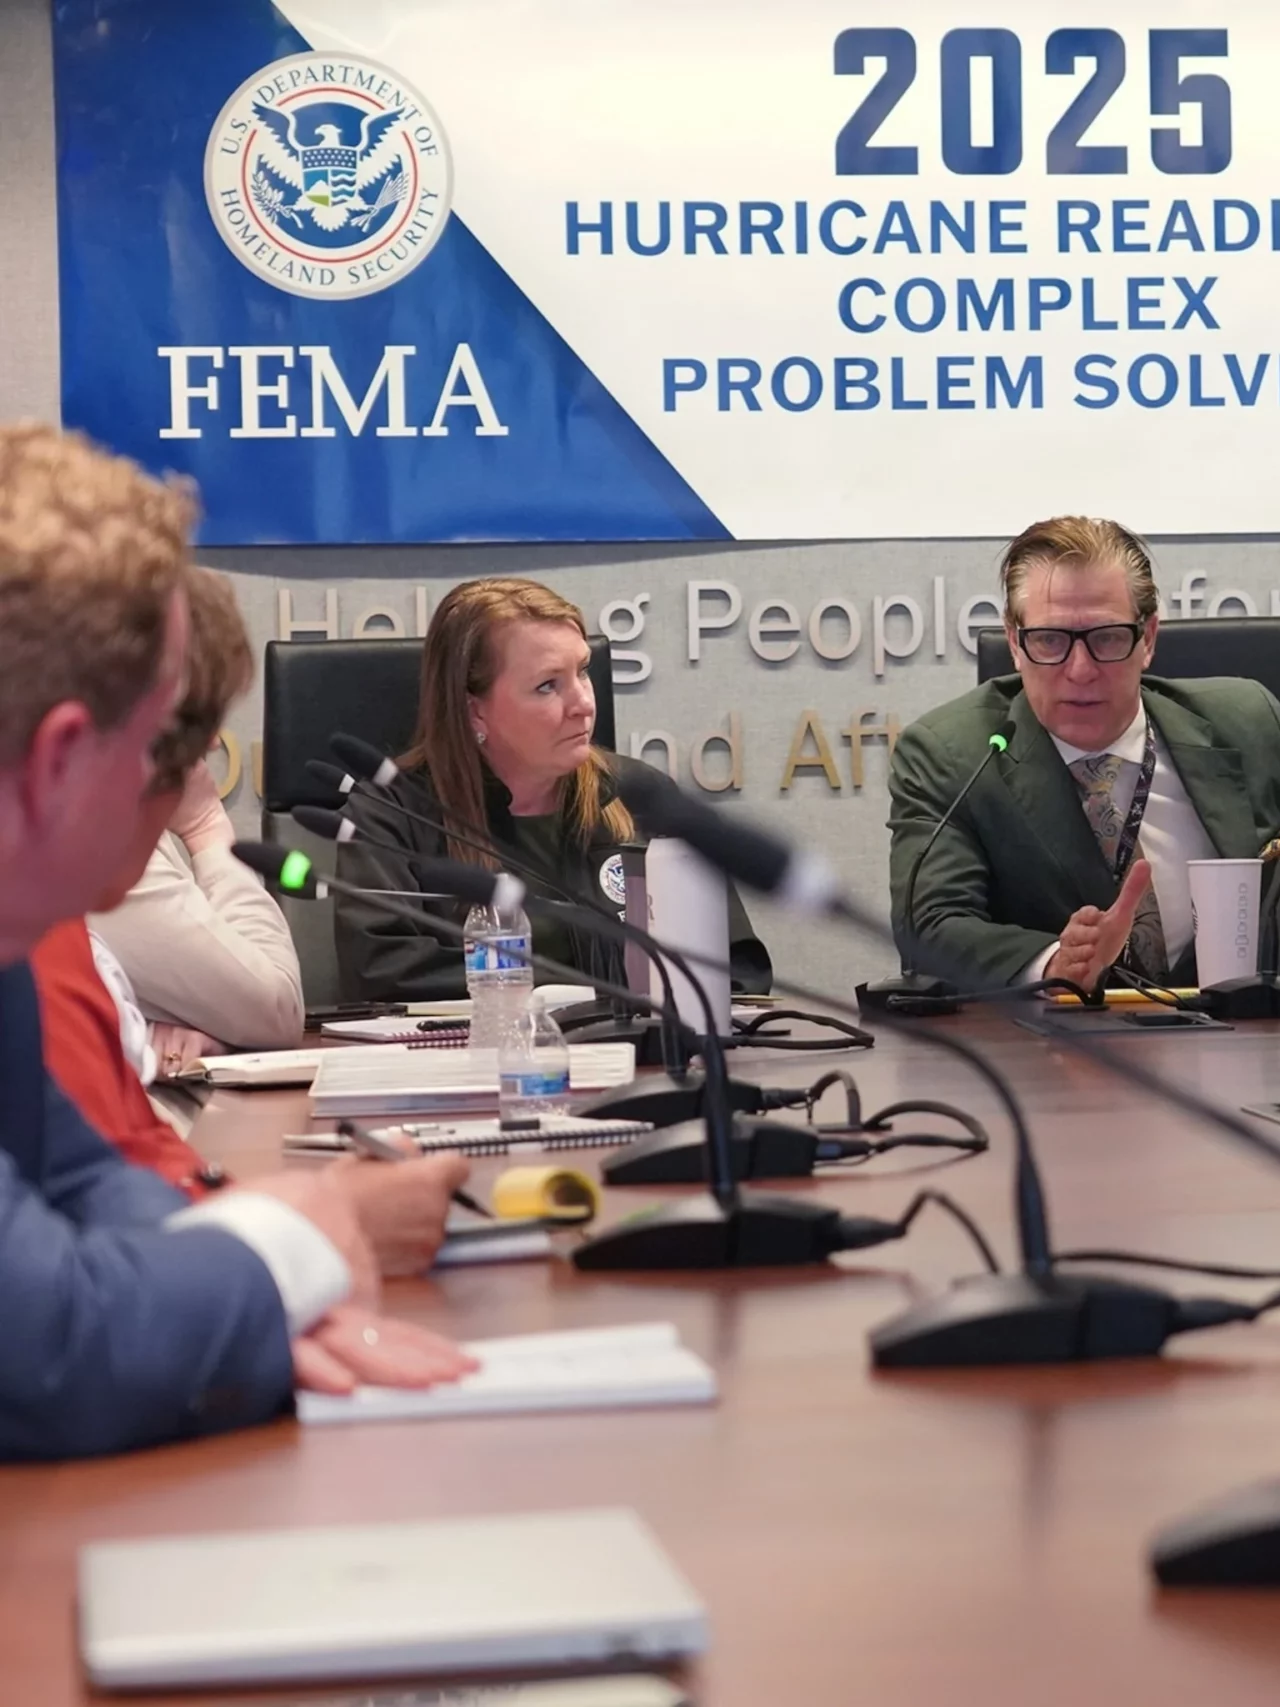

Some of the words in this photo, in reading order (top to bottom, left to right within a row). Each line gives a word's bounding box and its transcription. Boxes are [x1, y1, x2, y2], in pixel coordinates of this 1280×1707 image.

[220, 116, 253, 155] U.S.
[256, 64, 422, 124] DEPARTMENT
[413, 126, 440, 158] OF
[832, 27, 1233, 176] 2025
[220, 188, 337, 286] HOMELAND
[348, 188, 440, 286] SECURITY
[565, 200, 1028, 256] HURRICANE
[837, 276, 1221, 334] COMPLEX
[157, 341, 510, 440] FEMA
[662, 355, 1044, 413] PROBLEM
[686, 575, 1004, 677] People
